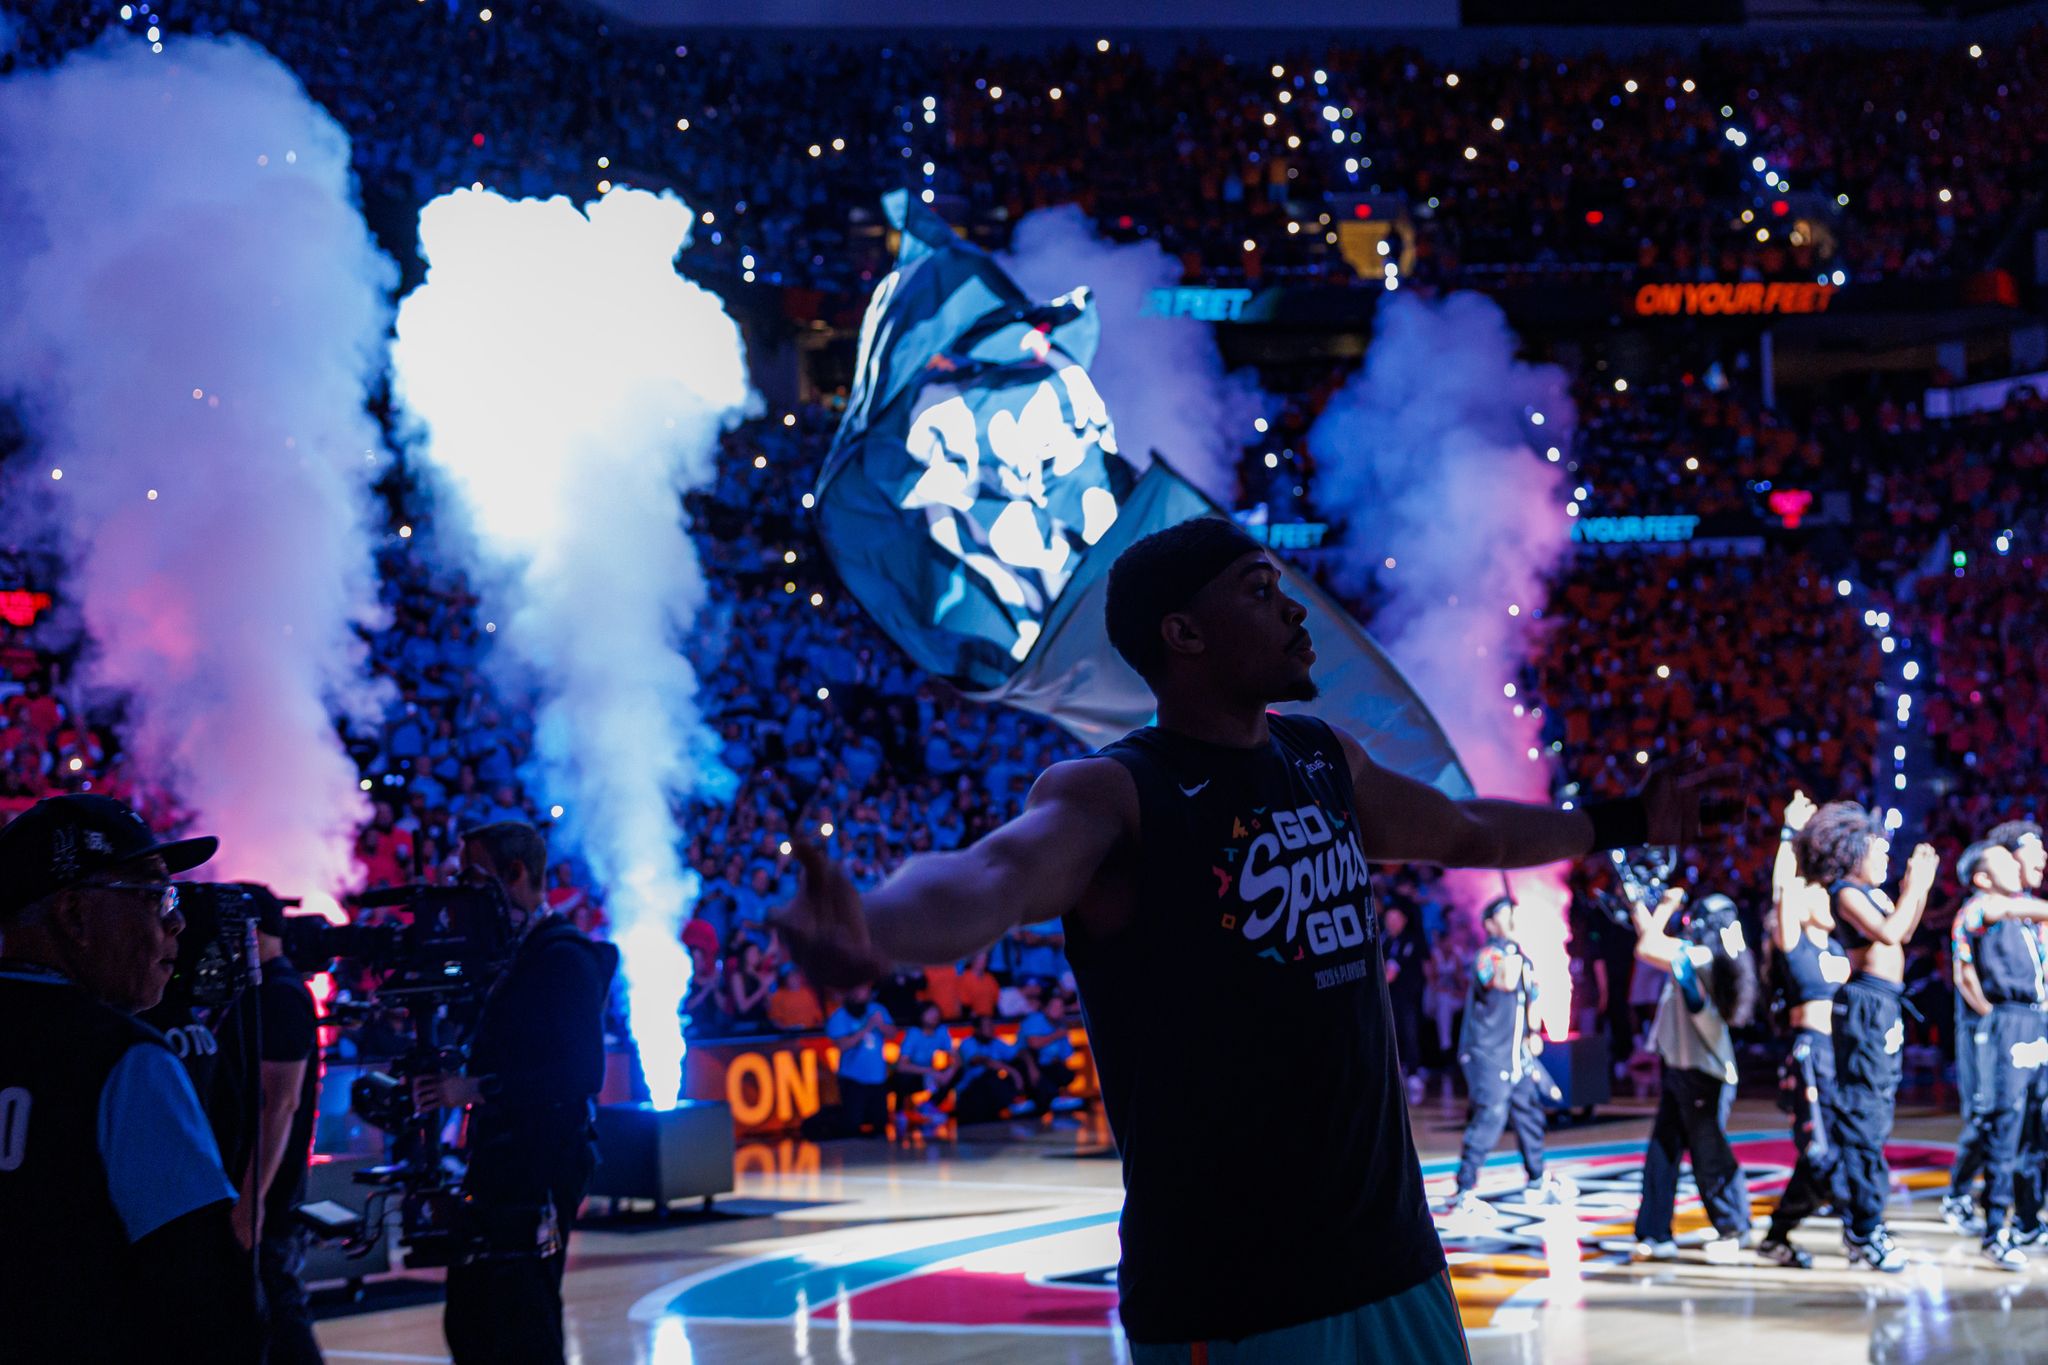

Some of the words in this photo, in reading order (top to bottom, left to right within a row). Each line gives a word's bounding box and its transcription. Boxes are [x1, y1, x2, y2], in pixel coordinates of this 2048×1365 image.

[1174, 286, 1253, 321] FEET
[1635, 283, 1684, 315] ON
[1684, 283, 1765, 315] YOUR
[1763, 282, 1838, 314] FEET
[1268, 523, 1328, 549] FEET
[1644, 515, 1700, 541] FEET
[1272, 804, 1332, 850] GO
[1239, 831, 1368, 943] Spurs
[1305, 903, 1364, 956] GO
[726, 1048, 821, 1125] ON
